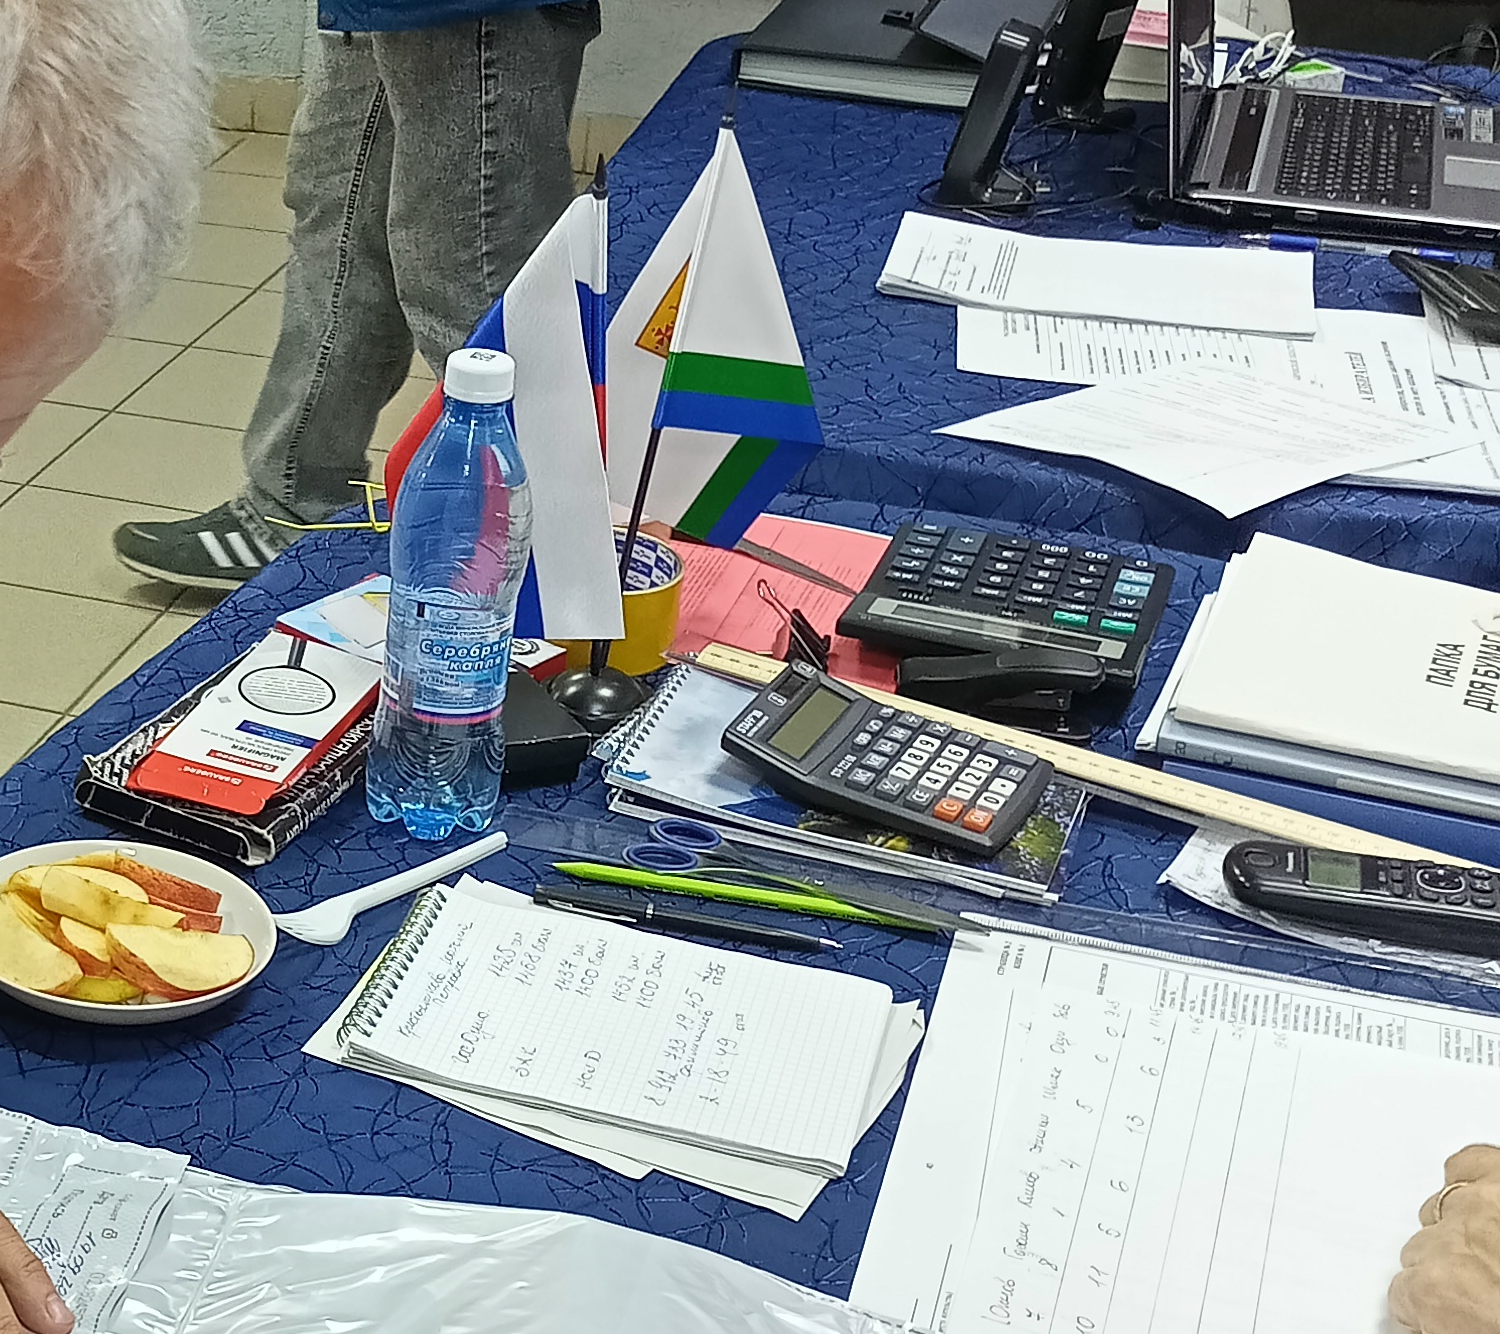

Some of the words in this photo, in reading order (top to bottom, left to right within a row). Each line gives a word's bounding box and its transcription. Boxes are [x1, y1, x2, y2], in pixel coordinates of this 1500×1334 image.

[1084, 550, 1109, 560] 00
[448, 655, 503, 672] капля
[1425, 643, 1466, 688] ПАПКА
[1463, 679, 1499, 714] ДЛЯ
[923, 738, 936, 750] 9
[231, 744, 287, 762] MAGNIFIER
[912, 750, 924, 762] 8
[952, 747, 965, 759] 6
[941, 761, 954, 772] 5
[979, 758, 993, 769] 3
[901, 765, 913, 778] 7
[966, 771, 980, 783] 2
[929, 775, 941, 787] 4
[956, 785, 968, 797] 1
[941, 800, 957, 813] C
[983, 795, 998, 807] 0
